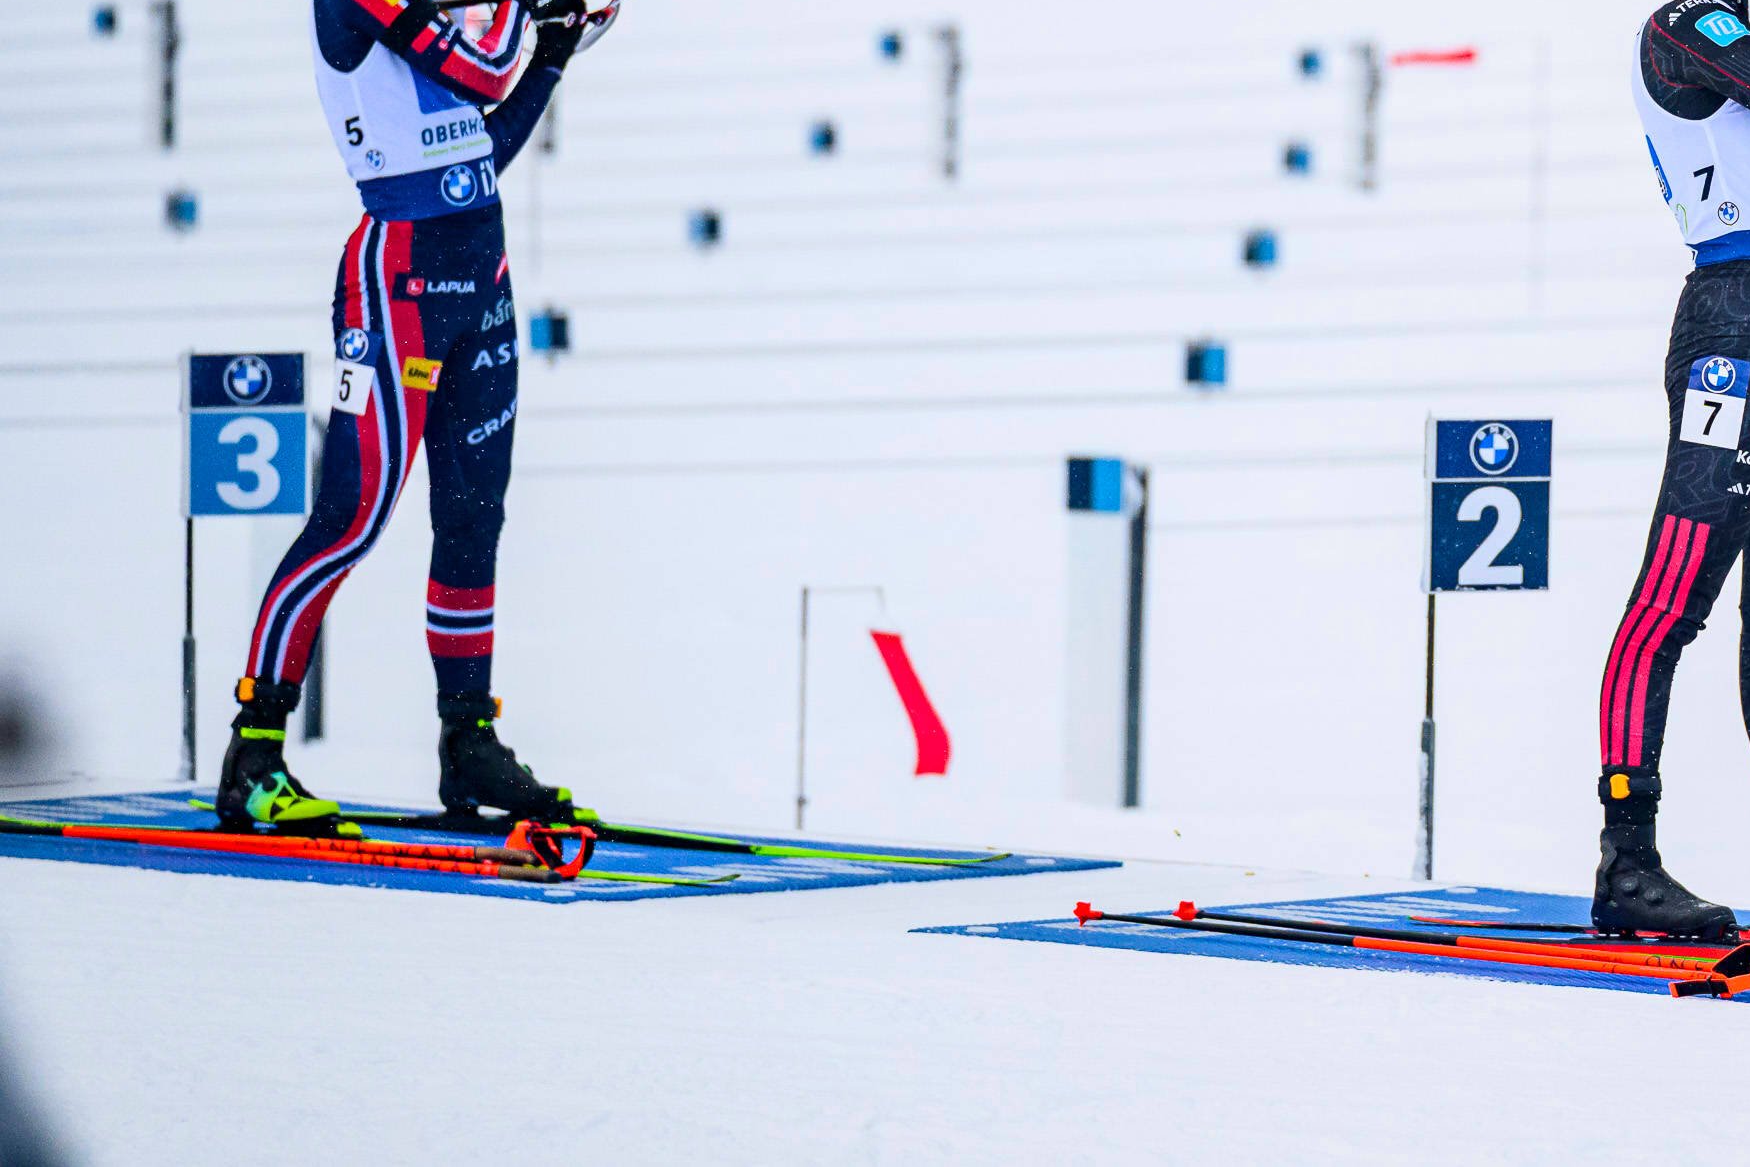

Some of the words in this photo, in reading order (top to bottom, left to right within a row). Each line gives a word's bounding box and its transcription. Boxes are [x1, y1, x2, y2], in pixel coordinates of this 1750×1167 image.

[344, 116, 363, 146] 5
[1693, 165, 1714, 202] 7
[427, 281, 476, 294] LAPUA
[339, 369, 353, 402] 5
[1703, 400, 1723, 436] 7
[216, 415, 281, 511] 3
[1457, 485, 1524, 586] 2
